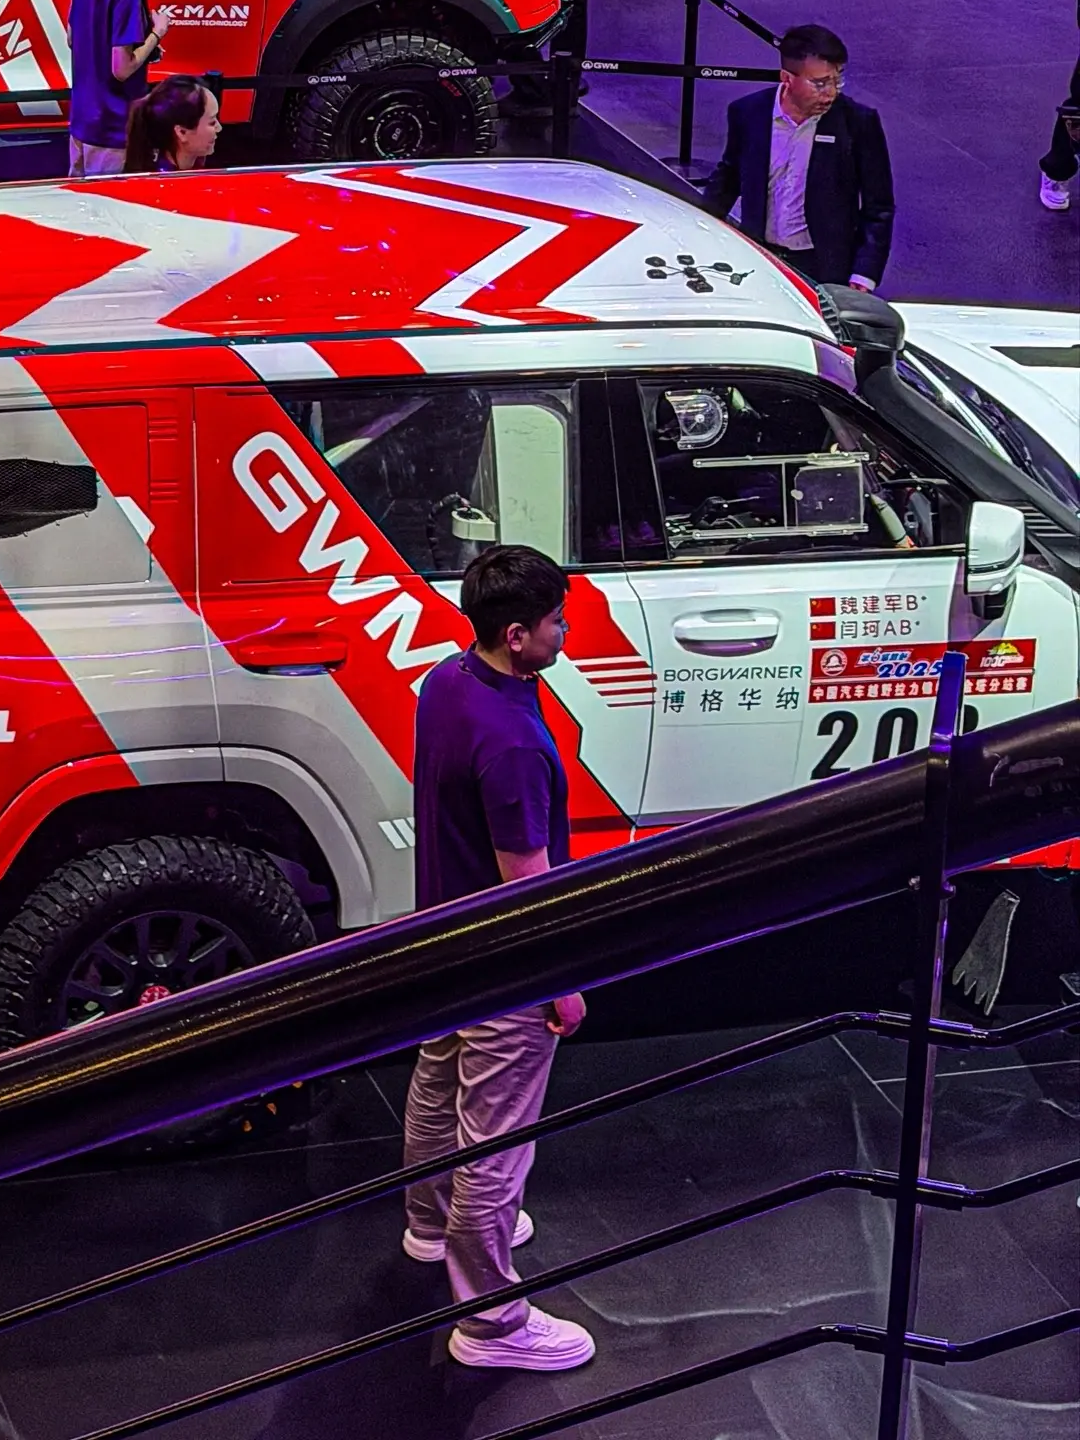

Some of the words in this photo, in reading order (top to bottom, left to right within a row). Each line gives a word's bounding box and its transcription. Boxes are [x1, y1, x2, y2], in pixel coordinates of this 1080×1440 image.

[451, 68, 477, 77] GWM
[593, 61, 619, 70] GWM
[713, 69, 738, 78] GWM
[320, 74, 347, 83] GWM
[232, 431, 463, 698] GWM
[663, 665, 803, 682] BORGWARNER
[877, 660, 943, 678] 2025
[662, 686, 800, 714] 博格华纳
[810, 706, 980, 780] 20
